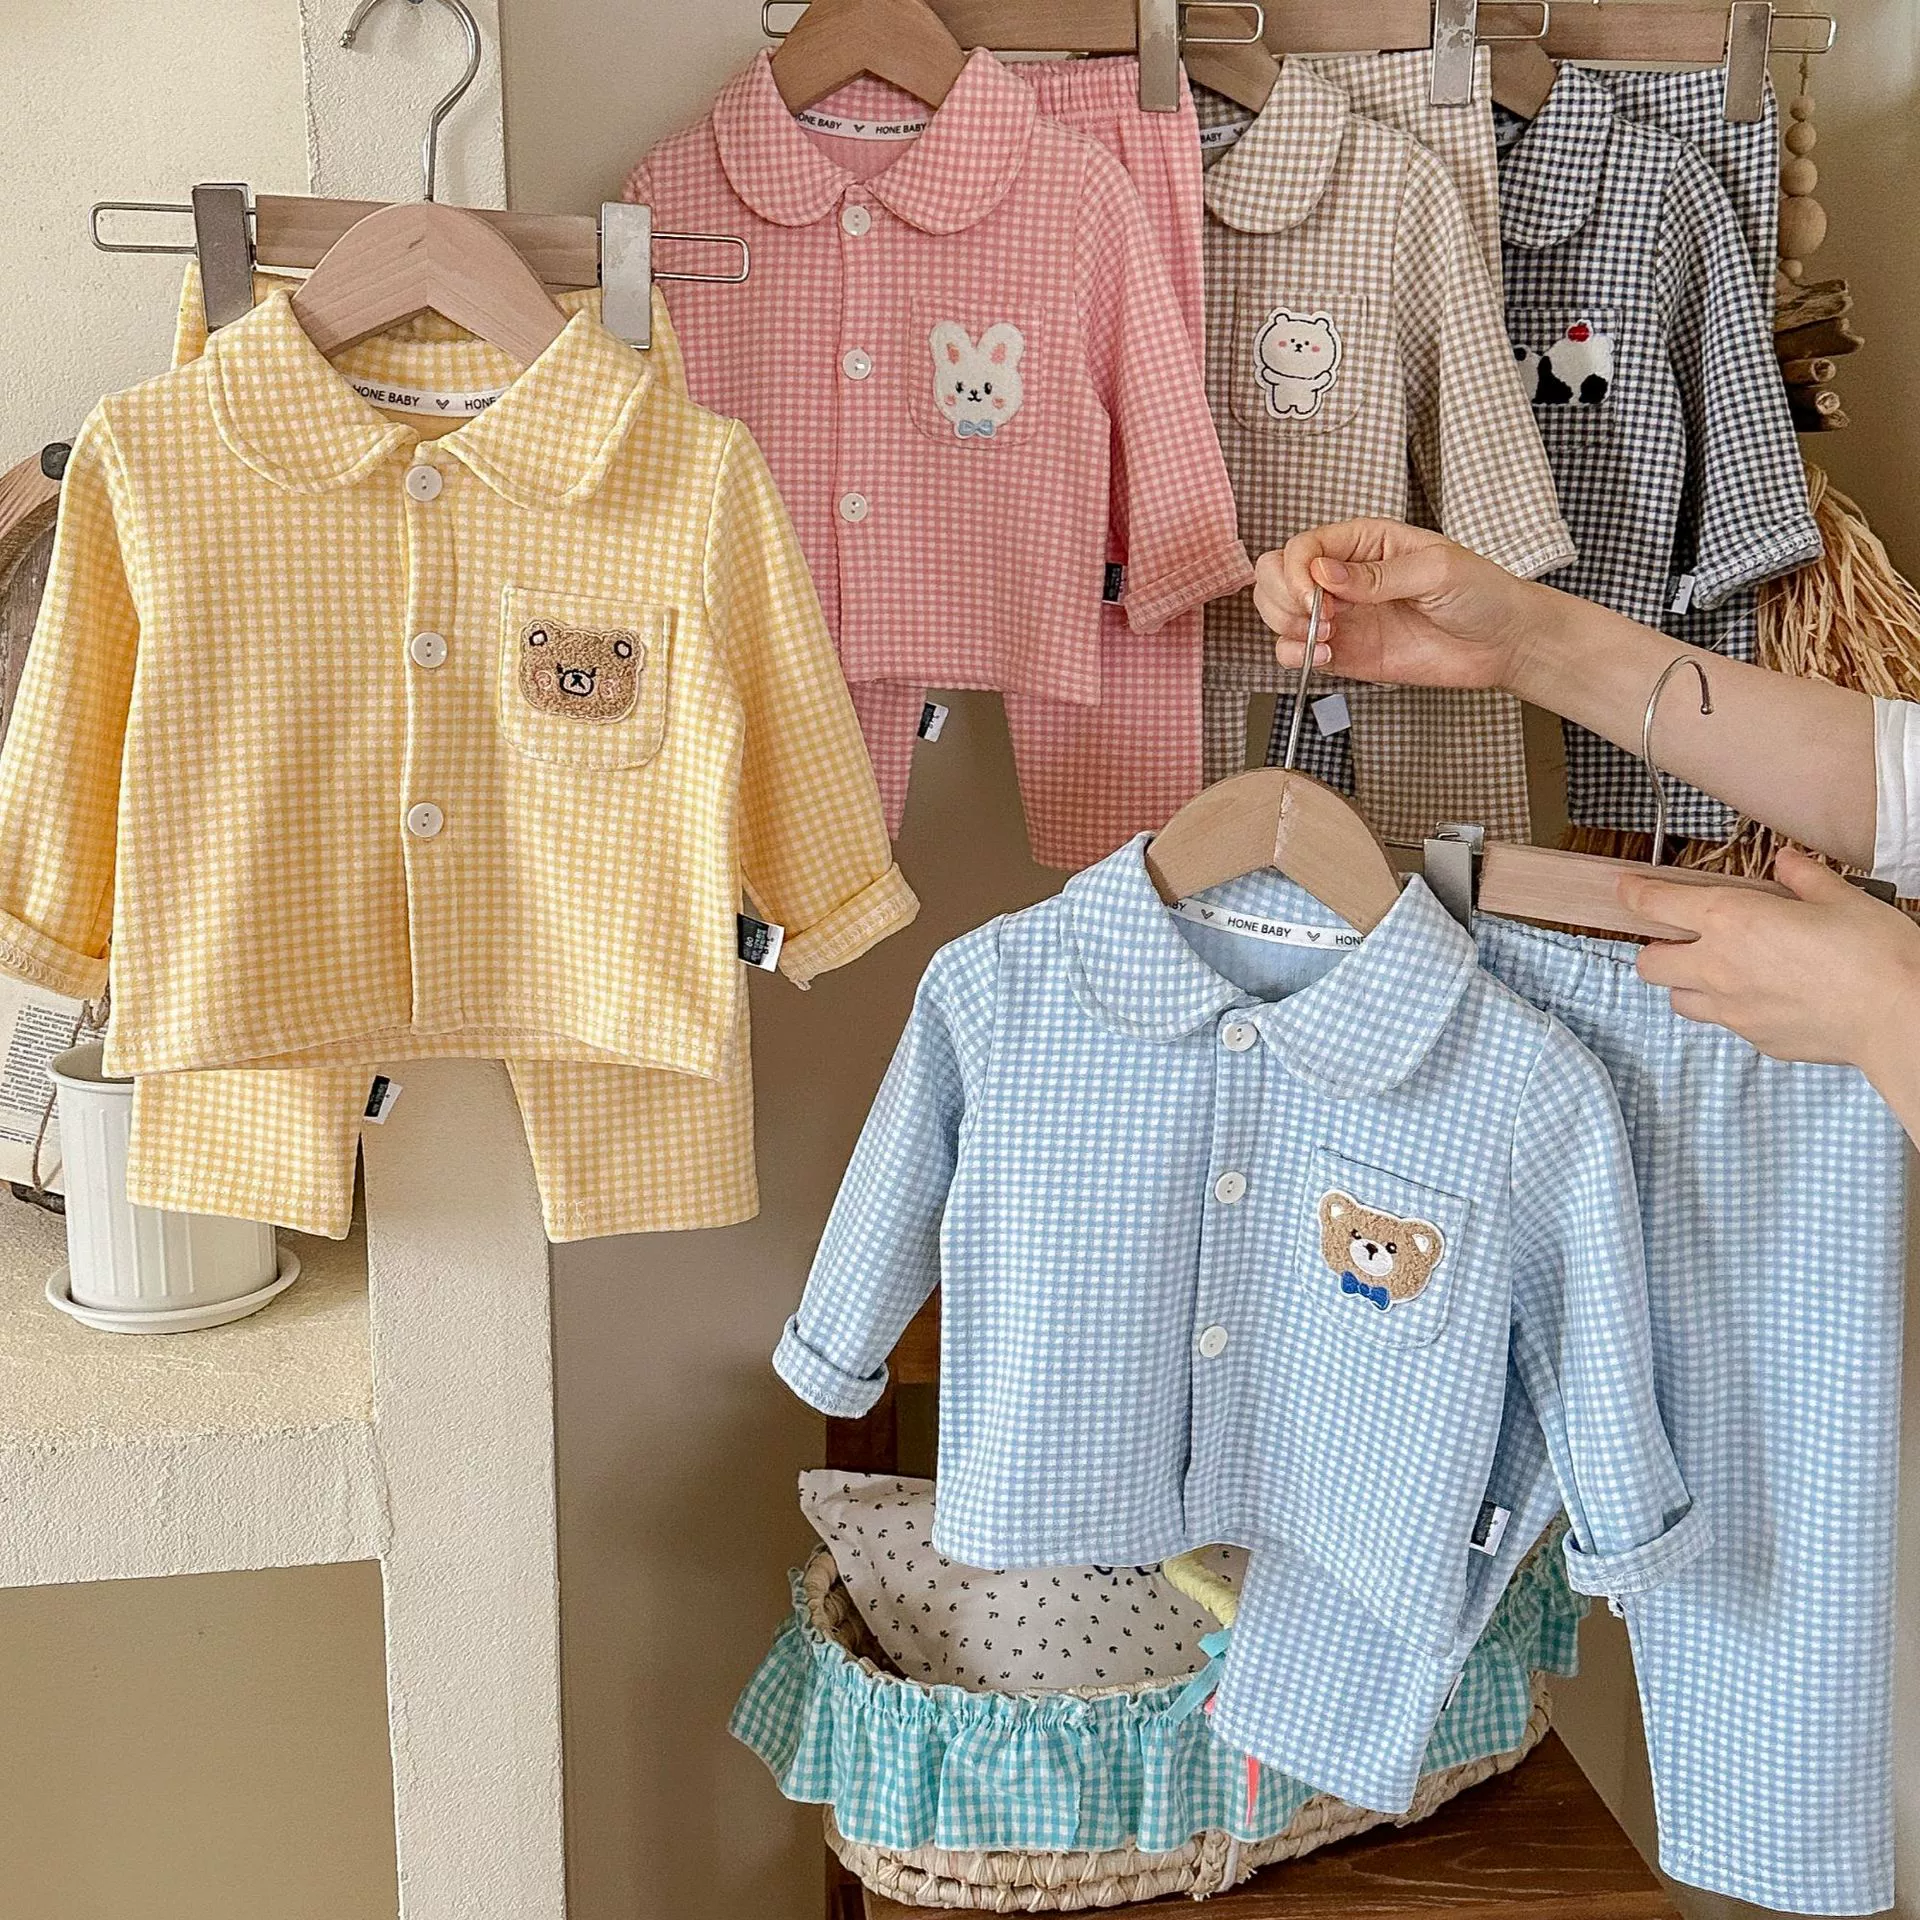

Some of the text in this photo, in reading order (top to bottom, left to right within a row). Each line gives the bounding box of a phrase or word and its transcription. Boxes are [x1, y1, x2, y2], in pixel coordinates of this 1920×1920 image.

[817, 118, 842, 130] BABY
[875, 122, 927, 135] HONE BABY
[388, 391, 421, 407] BABY
[1227, 915, 1292, 937] HONE BABY
